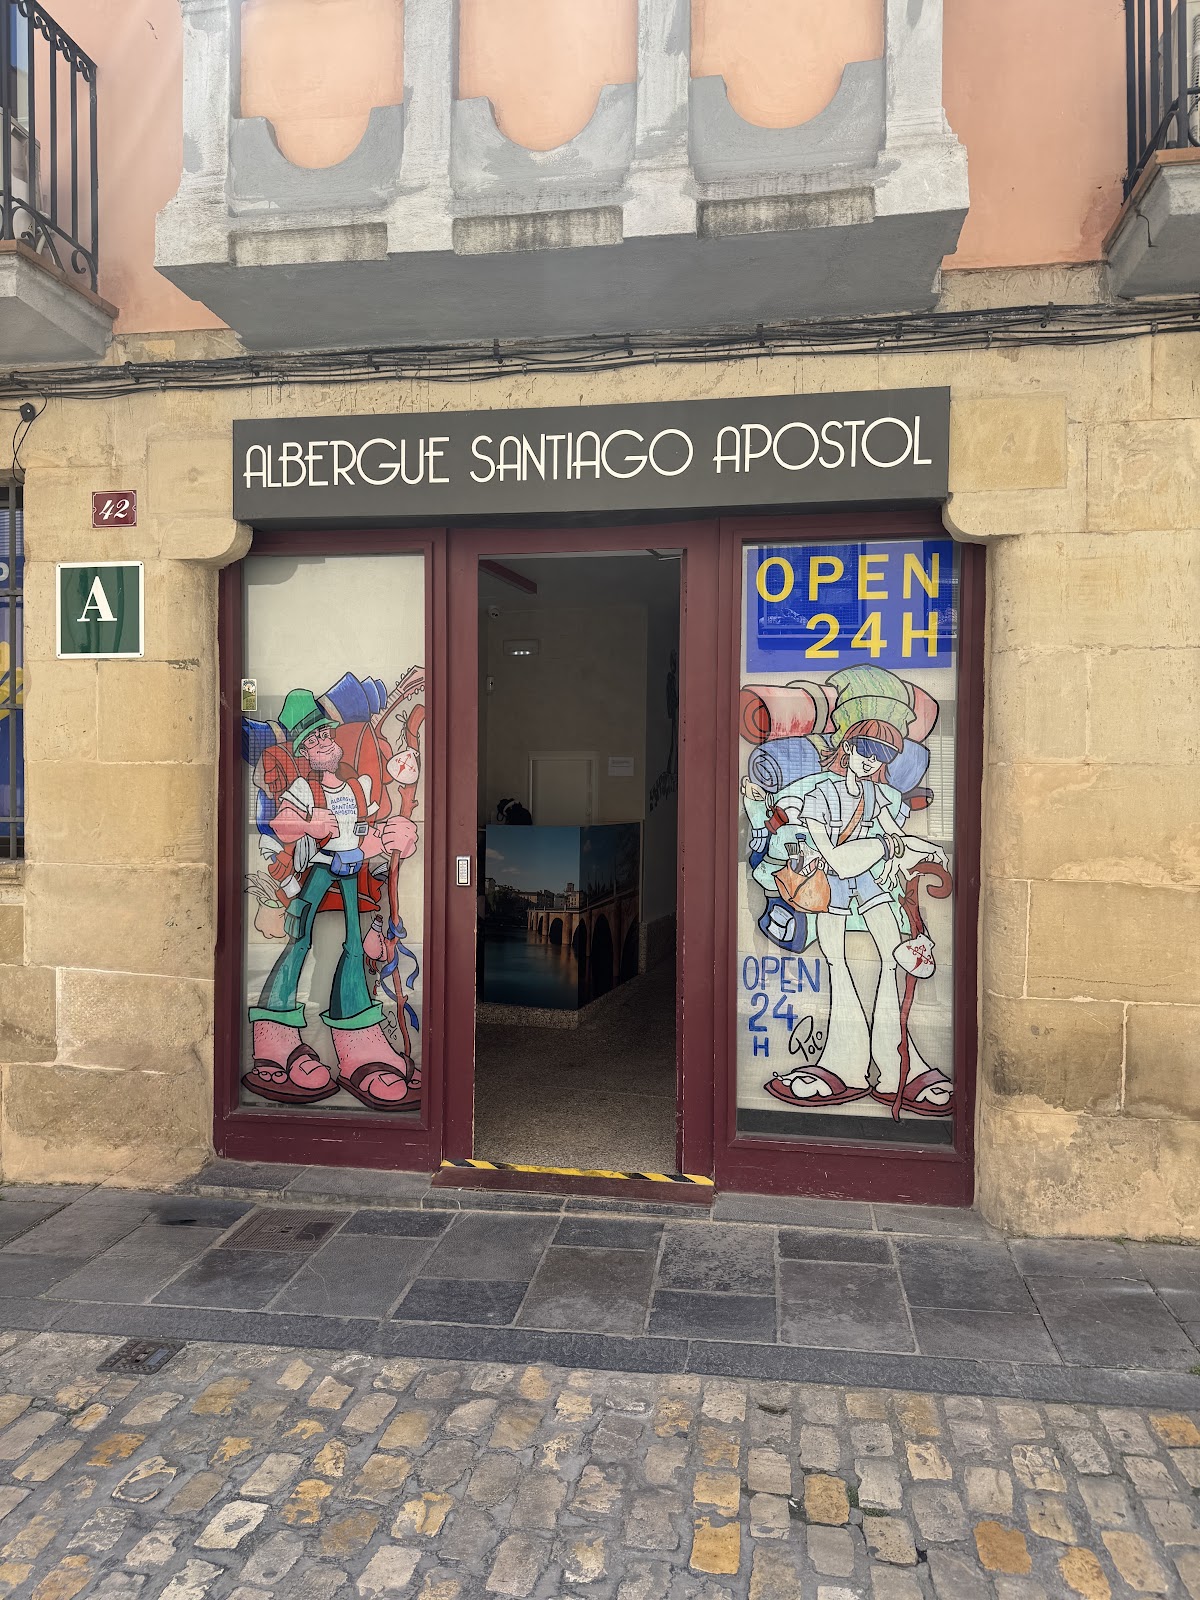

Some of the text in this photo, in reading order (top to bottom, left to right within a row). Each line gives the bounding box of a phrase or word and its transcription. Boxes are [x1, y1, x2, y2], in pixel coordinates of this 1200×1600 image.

[243, 416, 932, 488] ALBERGUE SANTIAGO APOSTOL
[98, 499, 130, 520] 42
[756, 553, 940, 602] OPEN
[76, 575, 118, 622] A
[743, 956, 821, 993] OPEN
[749, 992, 798, 1032] 24
[753, 1036, 770, 1057] H
